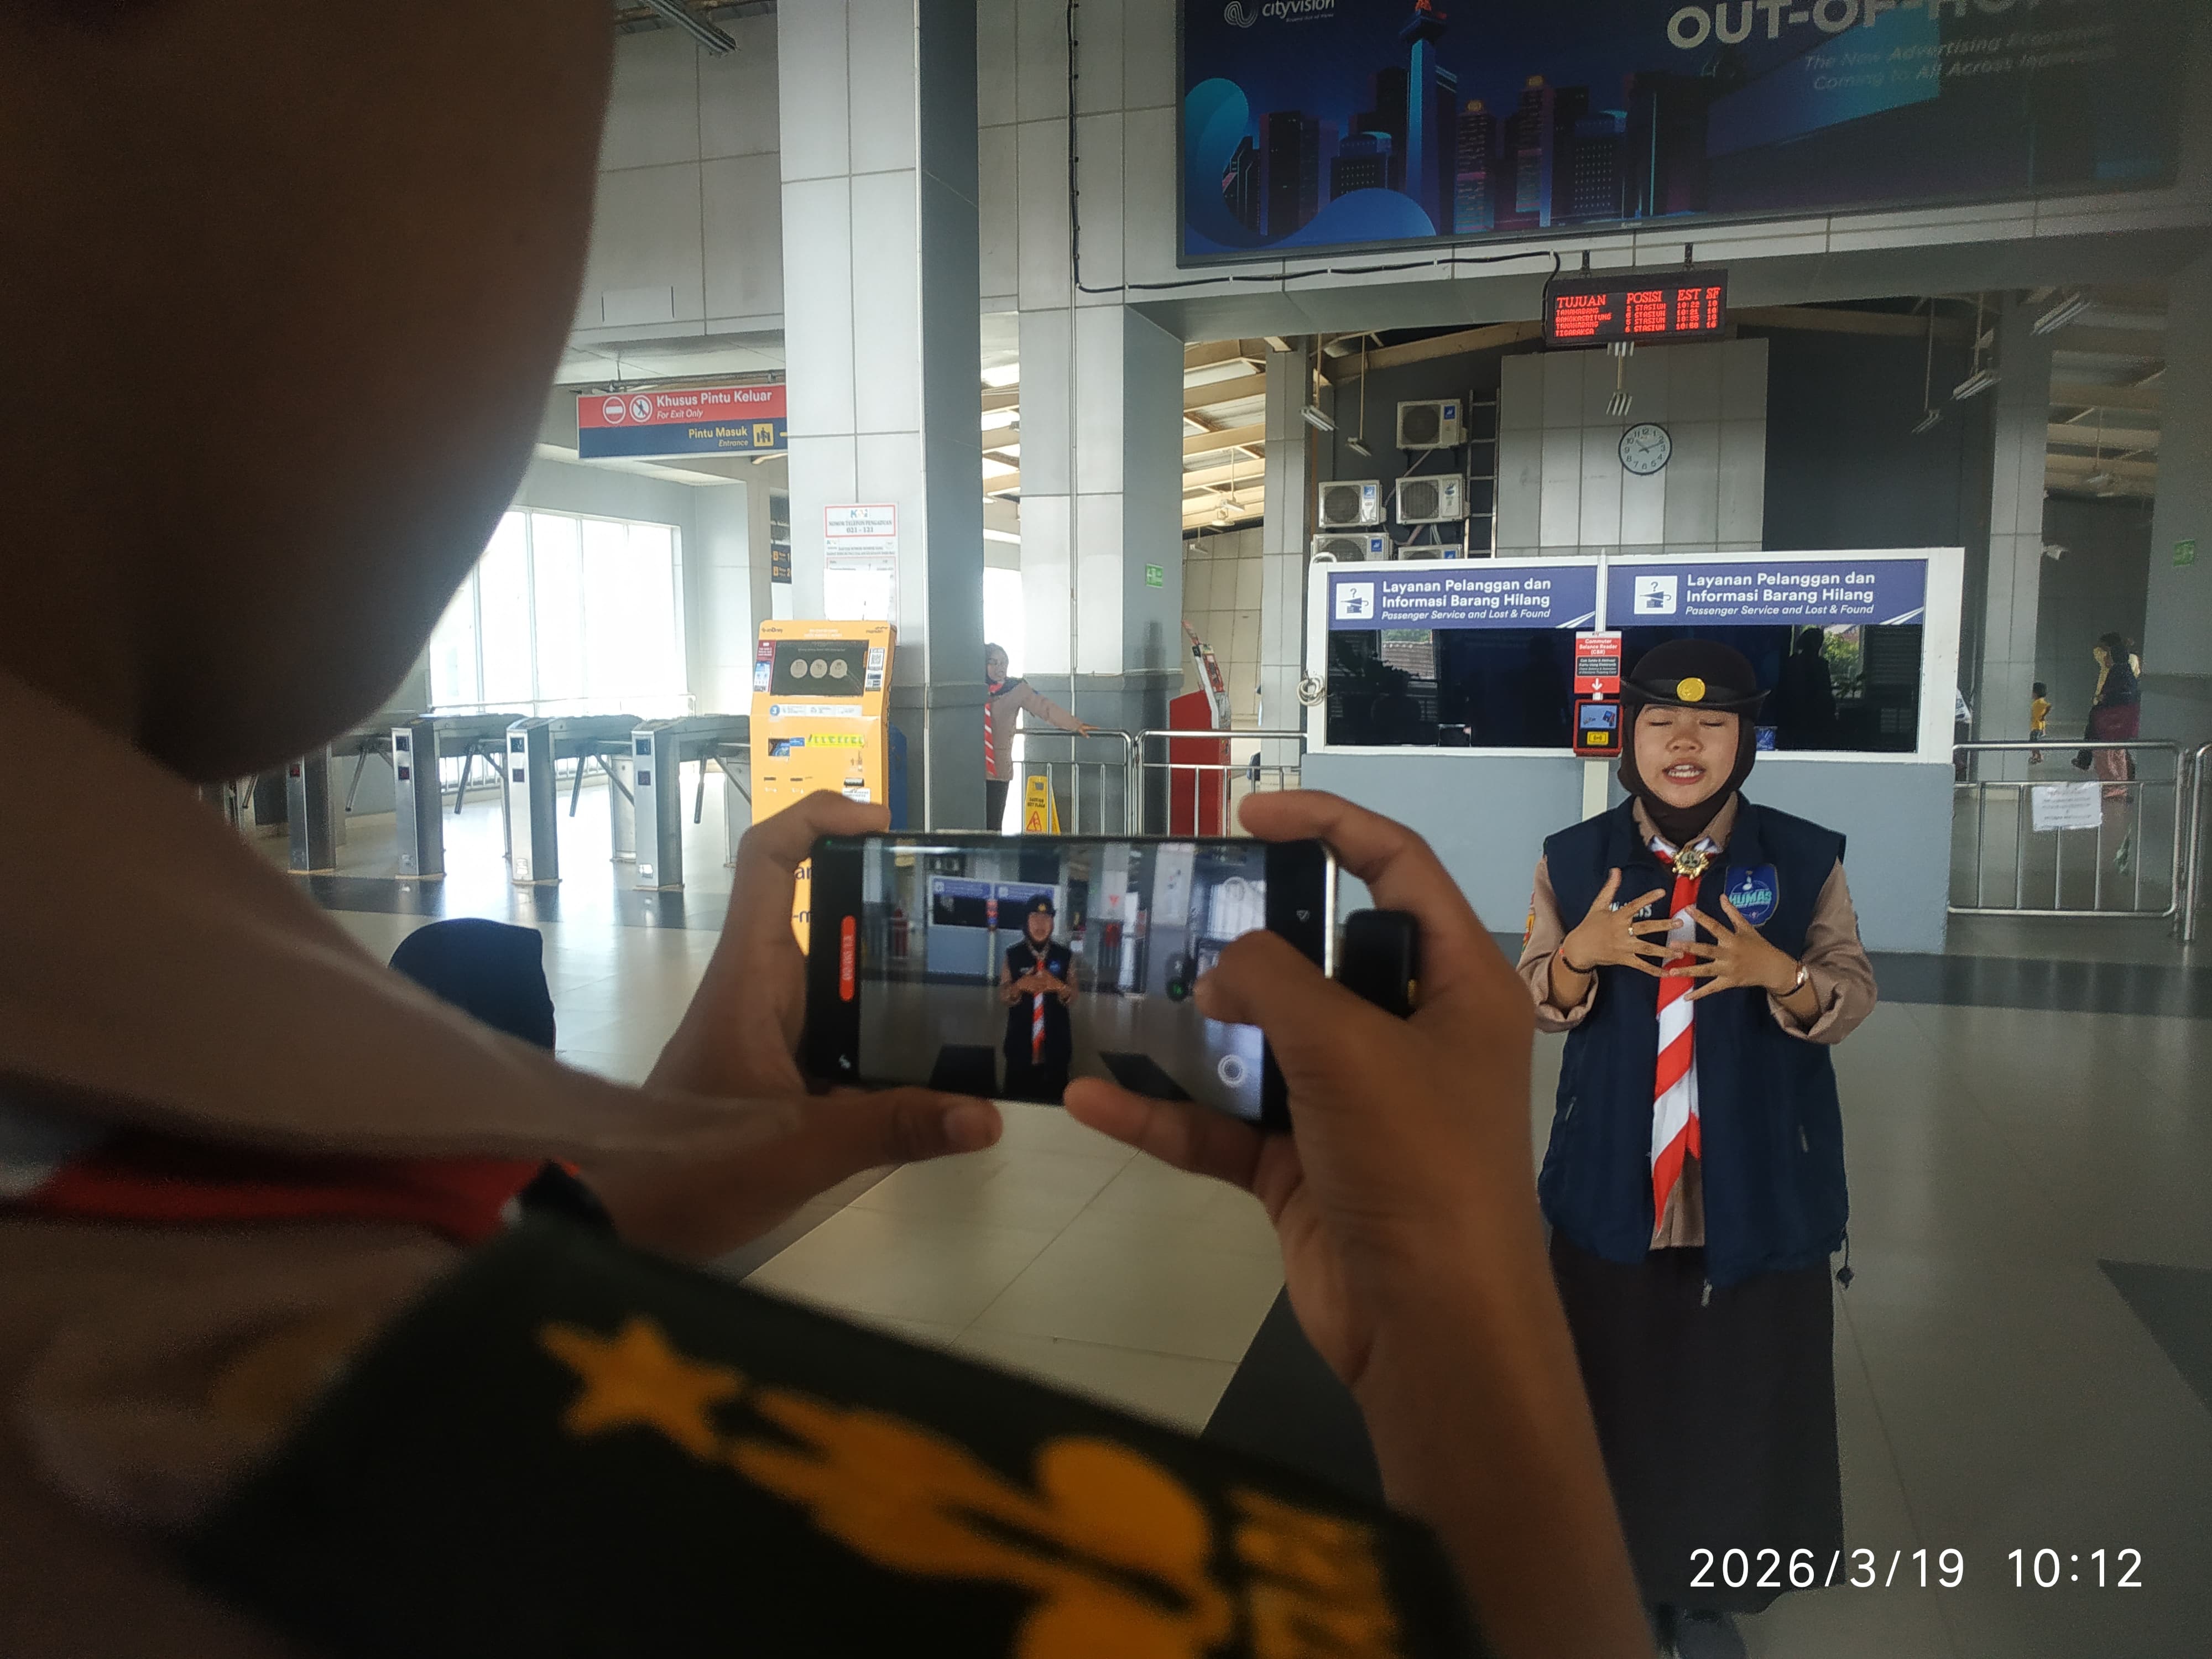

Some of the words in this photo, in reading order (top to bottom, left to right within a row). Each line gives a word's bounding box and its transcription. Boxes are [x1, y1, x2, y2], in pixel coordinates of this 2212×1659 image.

[1262, 0, 1334, 19] cityvision
[1805, 54, 1835, 71] The
[1557, 294, 1606, 308] TUJUAN
[1627, 291, 1662, 304] POSISI
[1677, 288, 1702, 301] EST
[656, 393, 697, 407] Khusus
[701, 391, 731, 405] Pintu
[734, 389, 772, 403] Keluar
[657, 409, 669, 419] For
[670, 409, 684, 419] Exit
[686, 409, 703, 419] Only
[688, 427, 713, 439] Pintu
[715, 426, 748, 438] Masuk
[718, 439, 749, 447] Entrance
[1383, 580, 1441, 596] Layanan
[1446, 578, 1520, 594] Pelanggan
[1524, 577, 1551, 591] dan
[1687, 573, 1752, 589] Layanan
[1757, 573, 1840, 587] Pelanggan
[1845, 572, 1875, 585] dan
[1382, 594, 1447, 608] Informasi
[1451, 594, 1499, 609] Barang
[1504, 593, 1550, 608] Hilang
[1687, 588, 1759, 602] Informasi
[1763, 589, 1818, 604] Barang
[1822, 588, 1874, 603] Hilang
[1381, 610, 1429, 622] Passenger
[1431, 609, 1465, 619] Service
[1468, 609, 1486, 619] and
[1489, 609, 1509, 618] Lost
[1510, 609, 1518, 618] &
[1520, 608, 1550, 618] Found
[1686, 606, 1738, 617] Passenger
[1741, 606, 1779, 614] Service
[1782, 606, 1802, 614] and
[1805, 605, 1827, 614] Lost
[1829, 605, 1838, 614] &
[1840, 604, 1875, 614] Found
[1729, 890, 1772, 905] HUMAS
